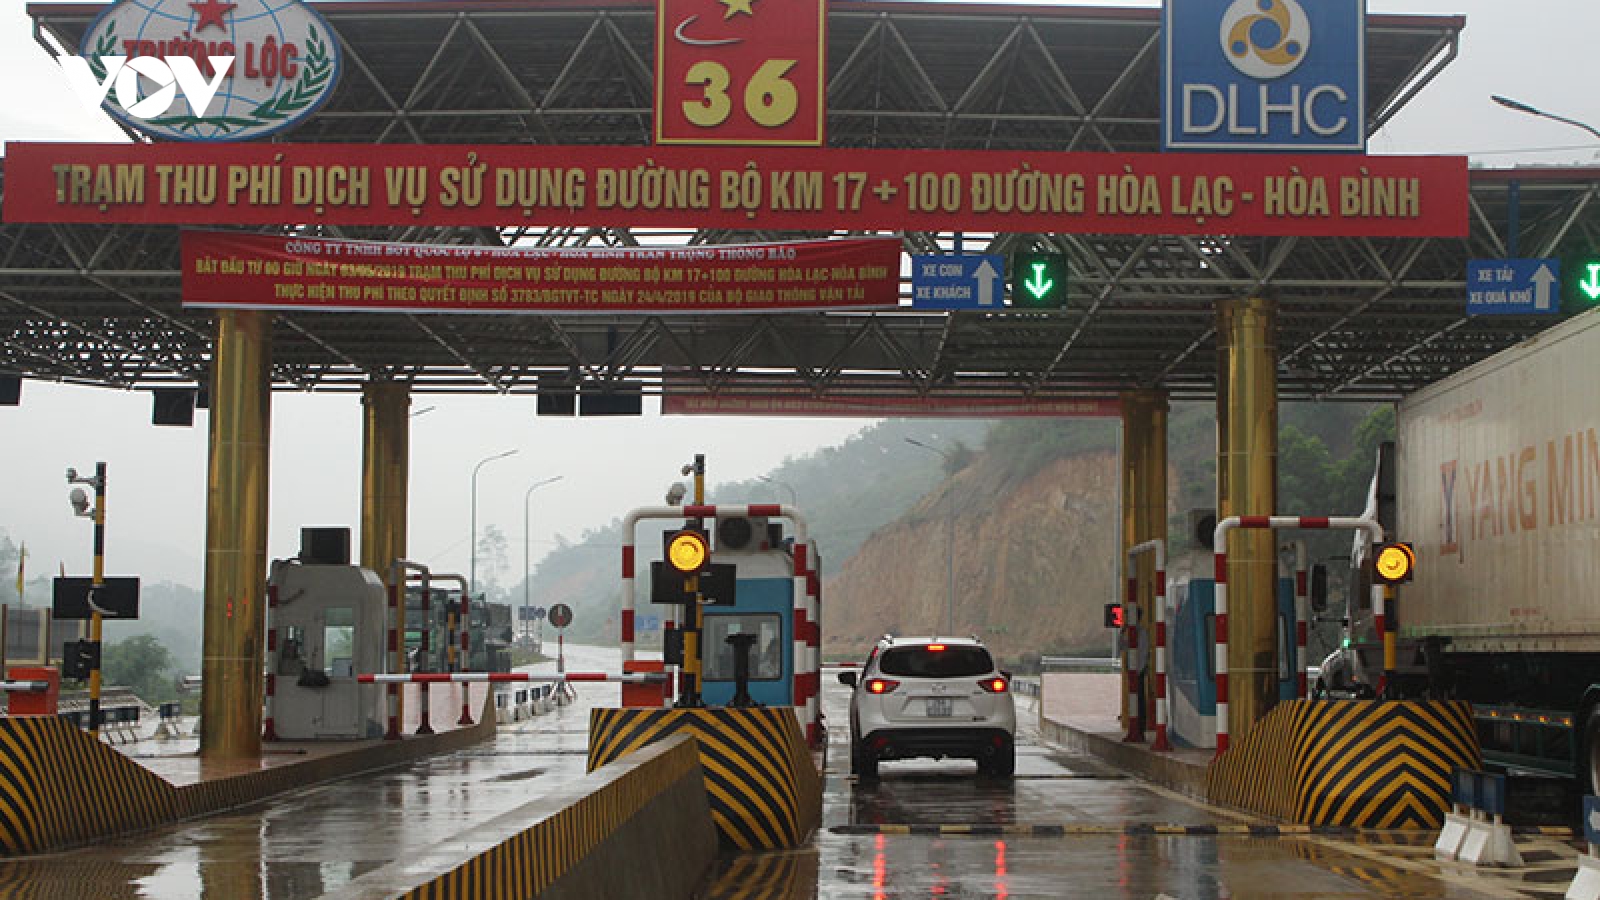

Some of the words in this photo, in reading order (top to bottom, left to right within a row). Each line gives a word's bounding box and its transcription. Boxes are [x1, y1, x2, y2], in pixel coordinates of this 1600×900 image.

[244, 34, 299, 88] LỘC
[681, 58, 799, 128] 36
[1182, 83, 1349, 136] DLHC
[52, 164, 146, 212] TRẠM
[156, 165, 217, 206] THU
[228, 153, 283, 206] PHÍ
[292, 165, 370, 215] DỊCH
[384, 166, 428, 216] VỤ
[439, 151, 488, 208] SỬ
[495, 167, 586, 217] DỤNG
[596, 157, 711, 210] ĐƯỜNG
[719, 159, 763, 219] BỘ
[770, 171, 823, 211] KM
[832, 171, 868, 211] 17
[903, 171, 961, 212] 100
[970, 161, 1085, 214] ĐƯỜNG
[1097, 164, 1162, 216] HÒA
[1171, 174, 1234, 225] LẠC
[1241, 190, 1254, 202] -
[1264, 165, 1331, 218] HÒA
[1340, 167, 1421, 218] BÌNH
[285, 240, 321, 254] CÔNG
[768, 244, 797, 260] BÁO
[195, 255, 218, 275] BẮT
[445, 265, 468, 280] THU
[470, 263, 491, 280] PHÍ
[525, 266, 541, 284] VỤ
[922, 264, 937, 277] XE
[939, 264, 963, 277] CON
[1477, 269, 1493, 282] XE
[338, 285, 361, 299] THU
[363, 283, 385, 300] PHÍ
[387, 286, 417, 301] THEO
[916, 285, 930, 299] XE
[933, 283, 972, 299] KHÁCH
[1469, 291, 1483, 304] XE
[1463, 445, 1538, 541] YANG
